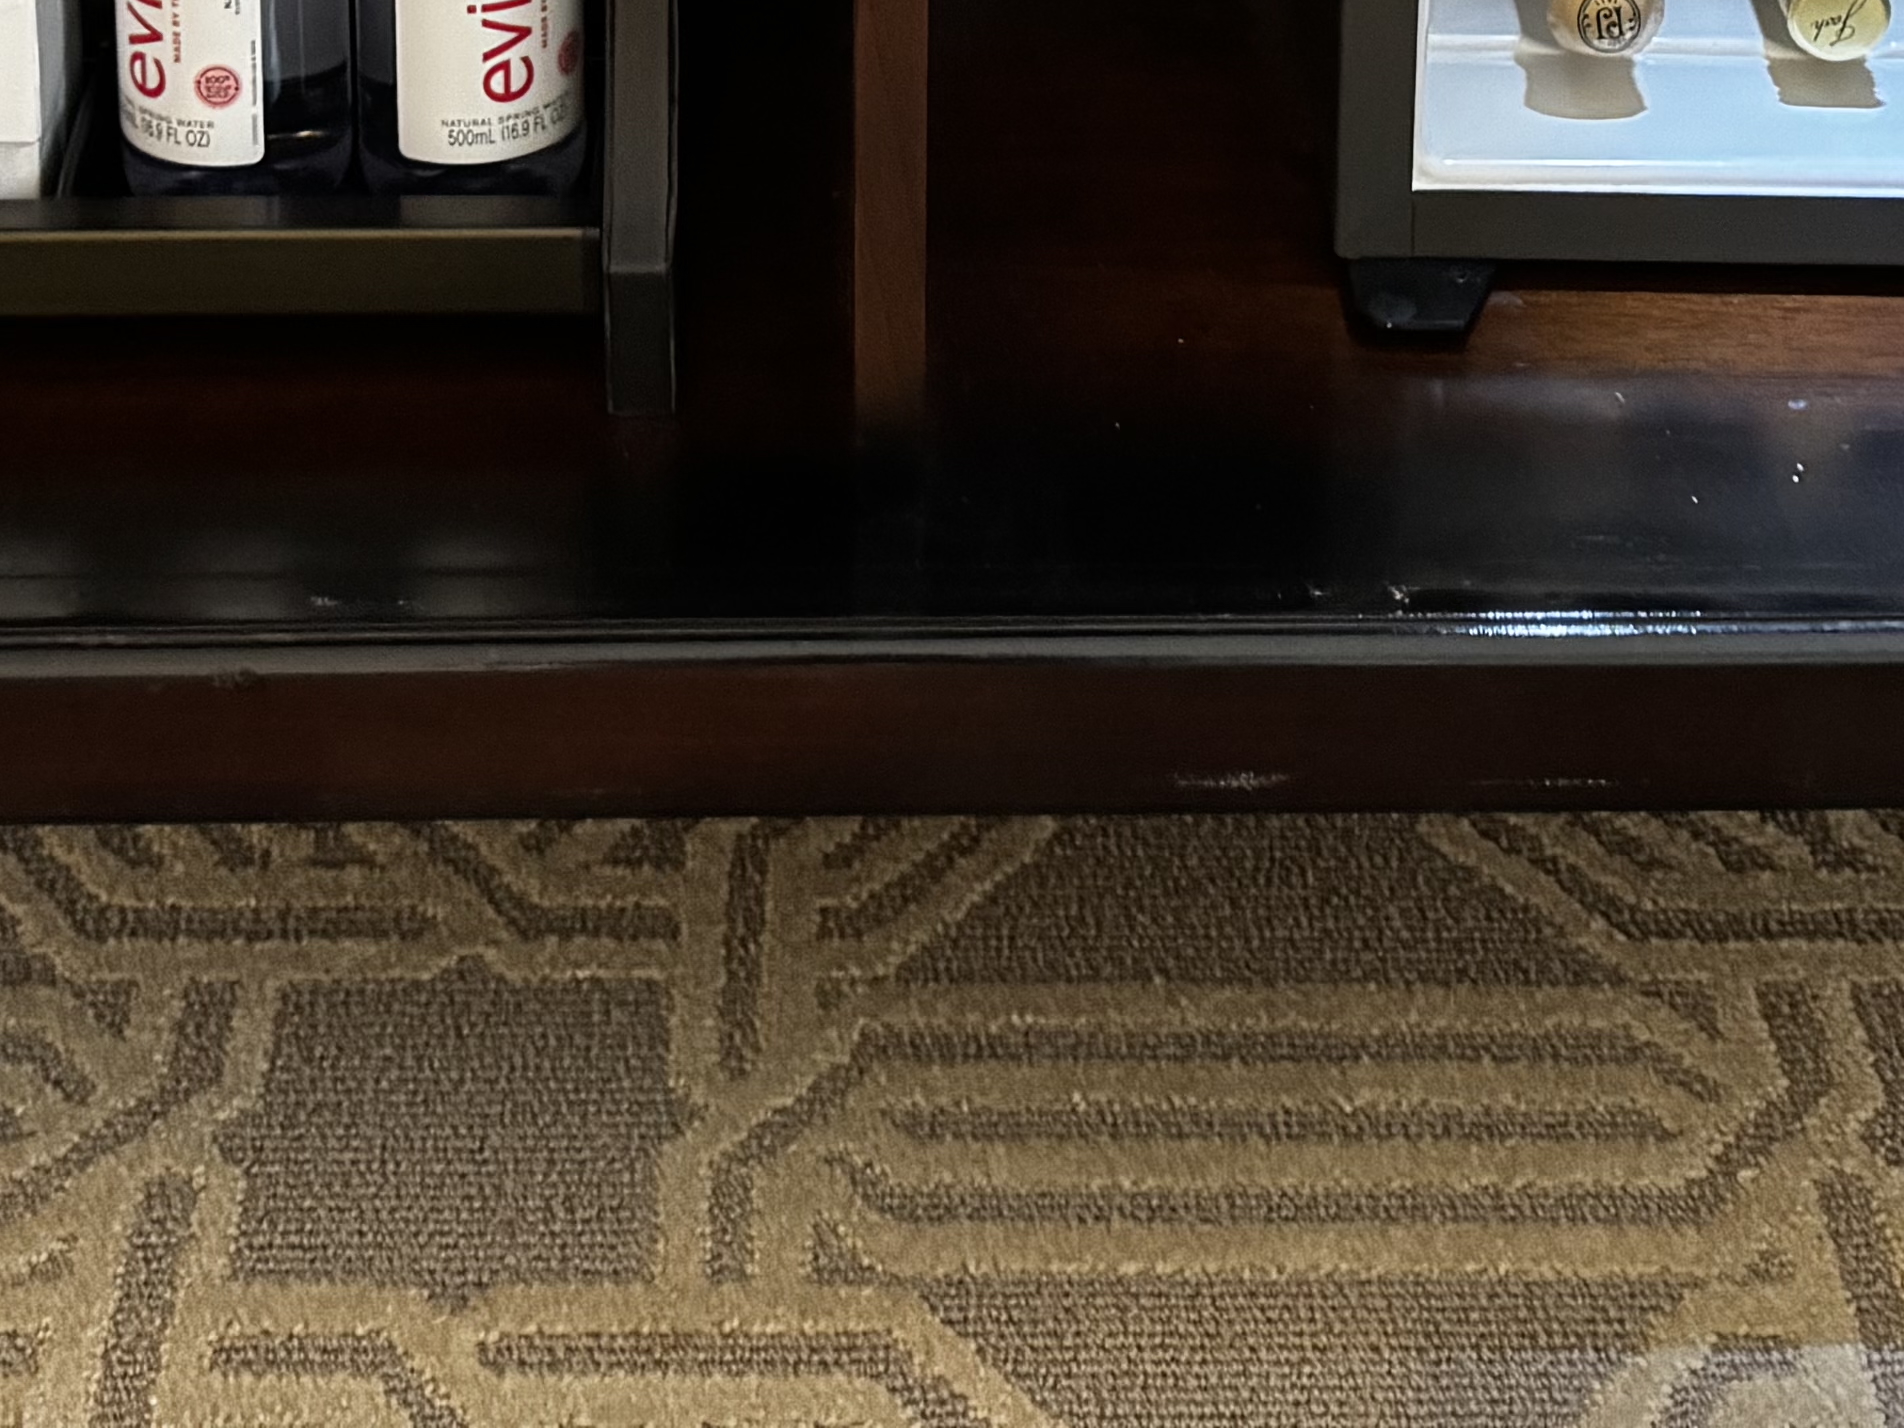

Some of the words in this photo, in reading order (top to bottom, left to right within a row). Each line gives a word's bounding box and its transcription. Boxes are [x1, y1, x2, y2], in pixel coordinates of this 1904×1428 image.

[172, 12, 181, 29] BY
[173, 32, 182, 64] MADE
[176, 119, 215, 130] WATER
[441, 117, 492, 128] NATURAL
[165, 126, 182, 145] FL
[447, 127, 496, 146] 500mL
